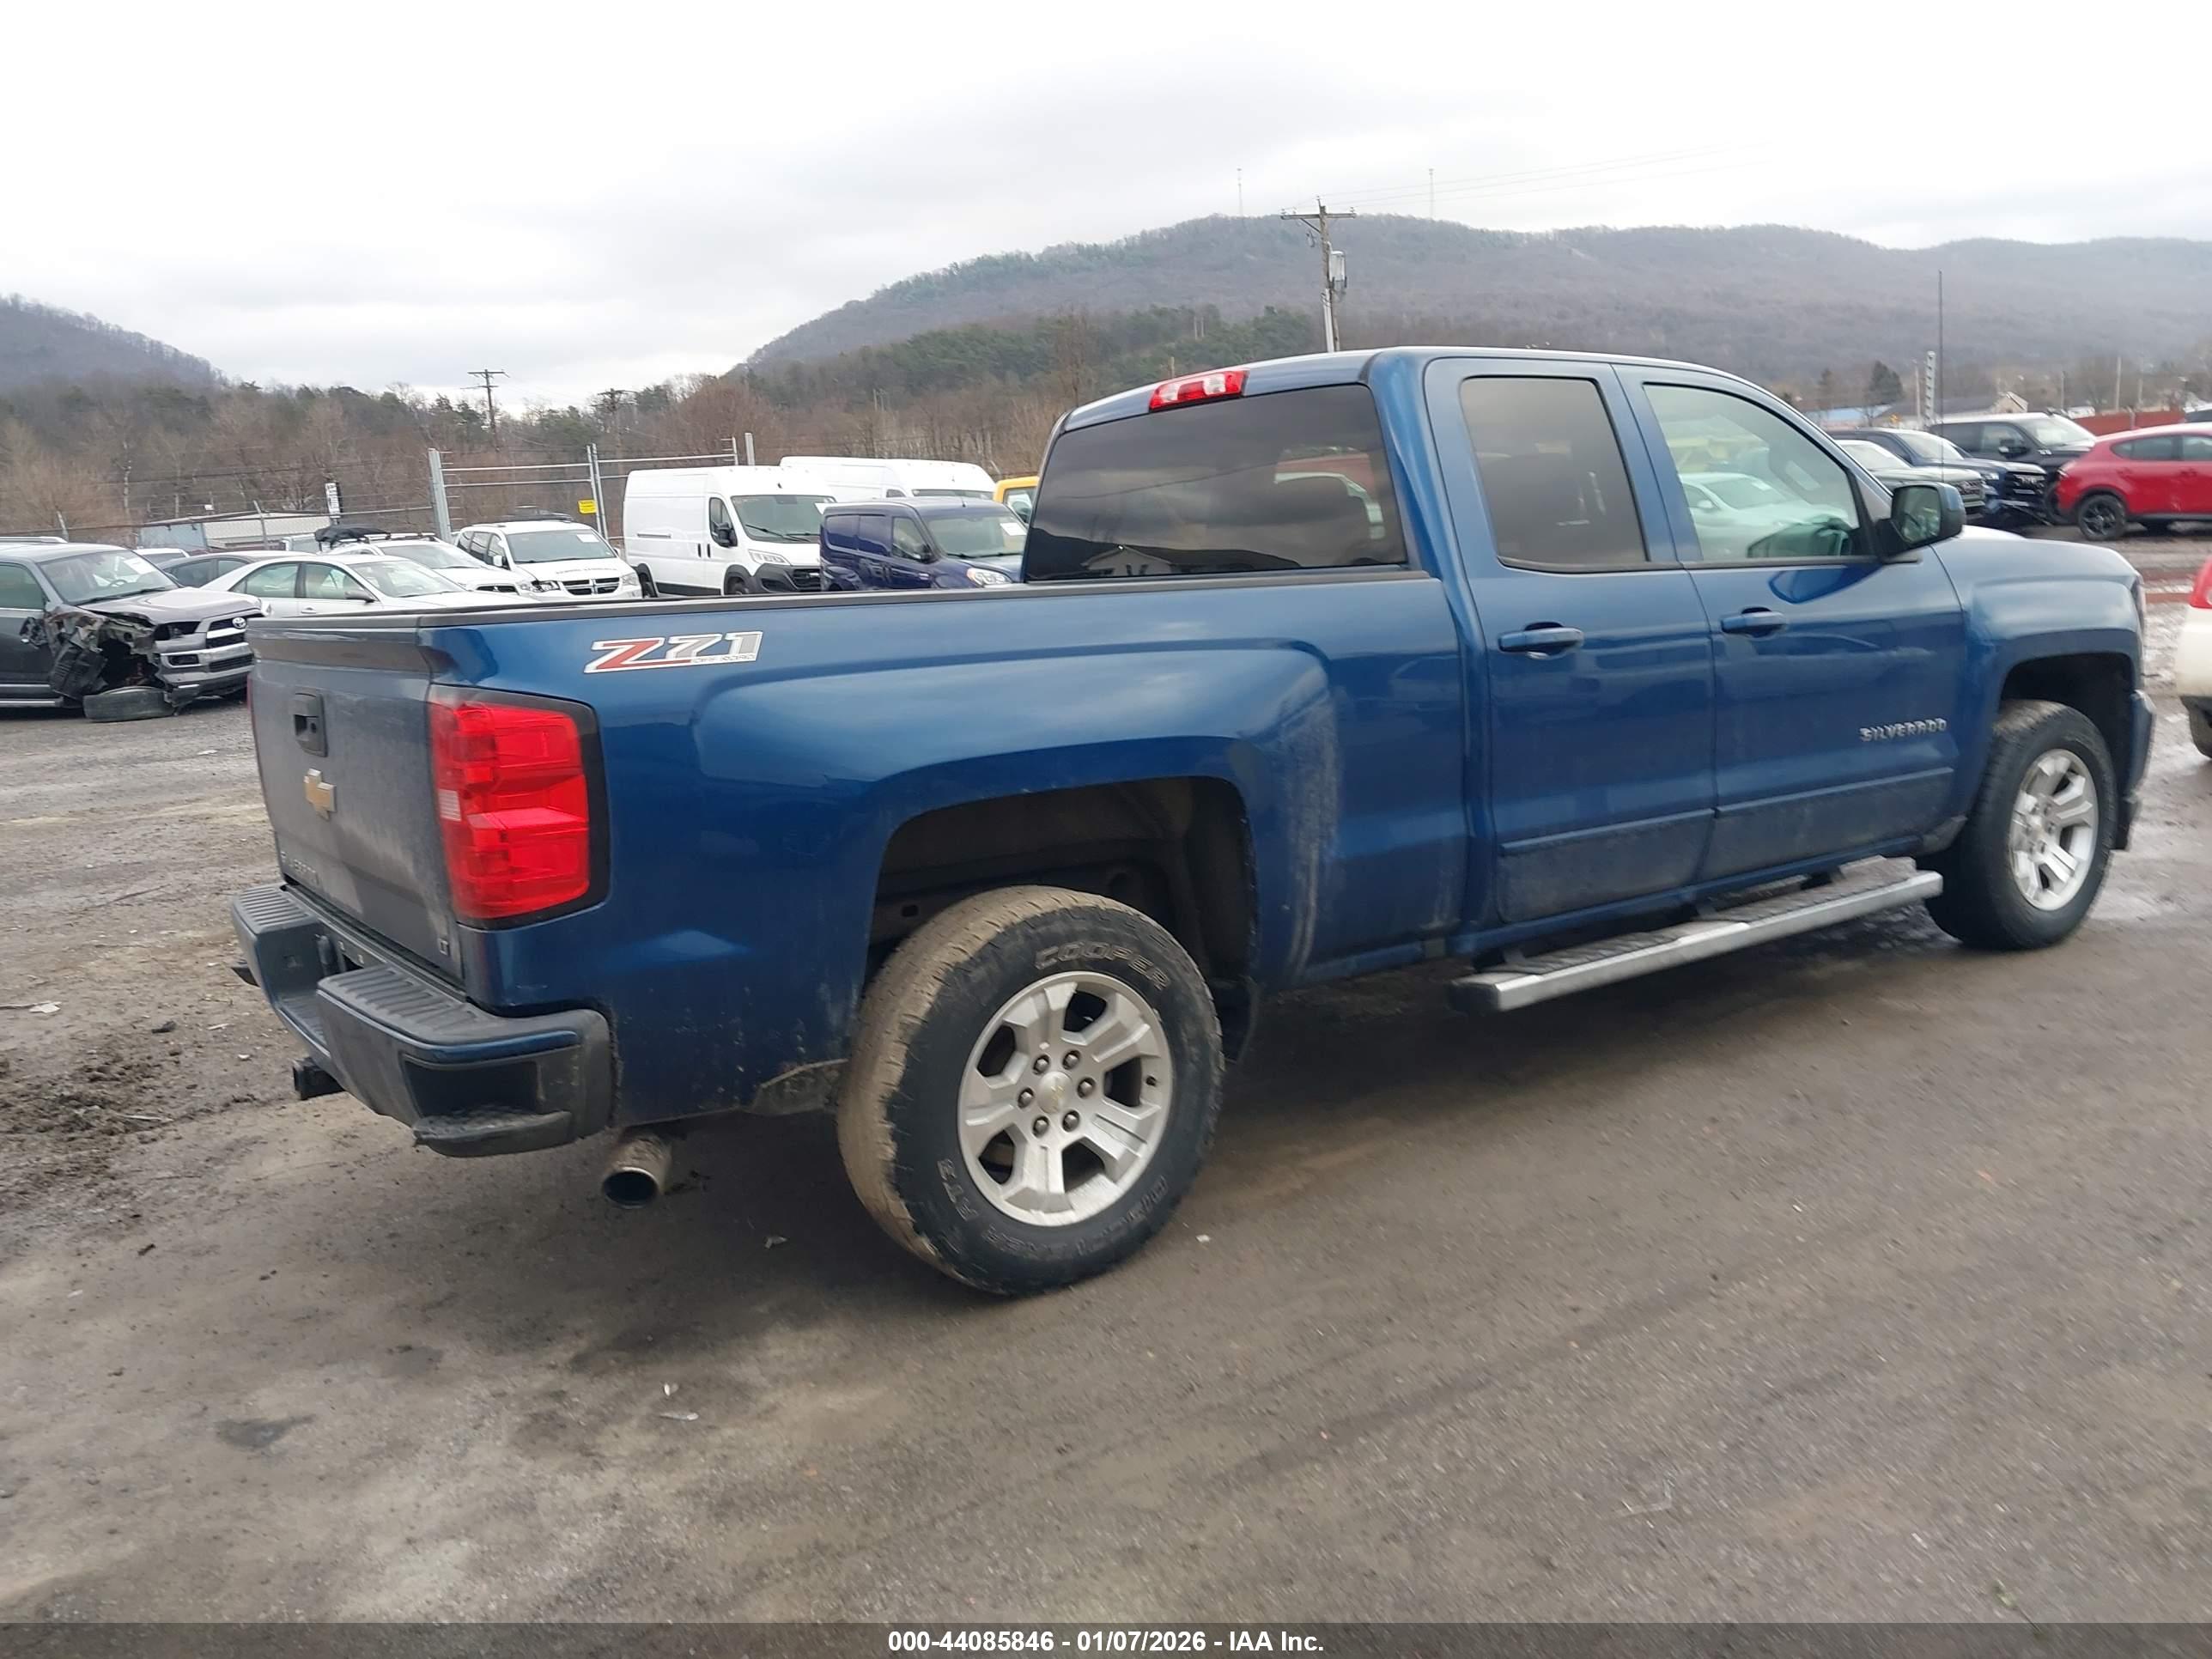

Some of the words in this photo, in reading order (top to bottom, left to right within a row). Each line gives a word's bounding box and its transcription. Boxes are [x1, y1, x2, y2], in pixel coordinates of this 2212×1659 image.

[584, 631, 763, 673] Z71
[1859, 717, 1948, 742] SILVERADO
[1034, 940, 1171, 991] COOPER
